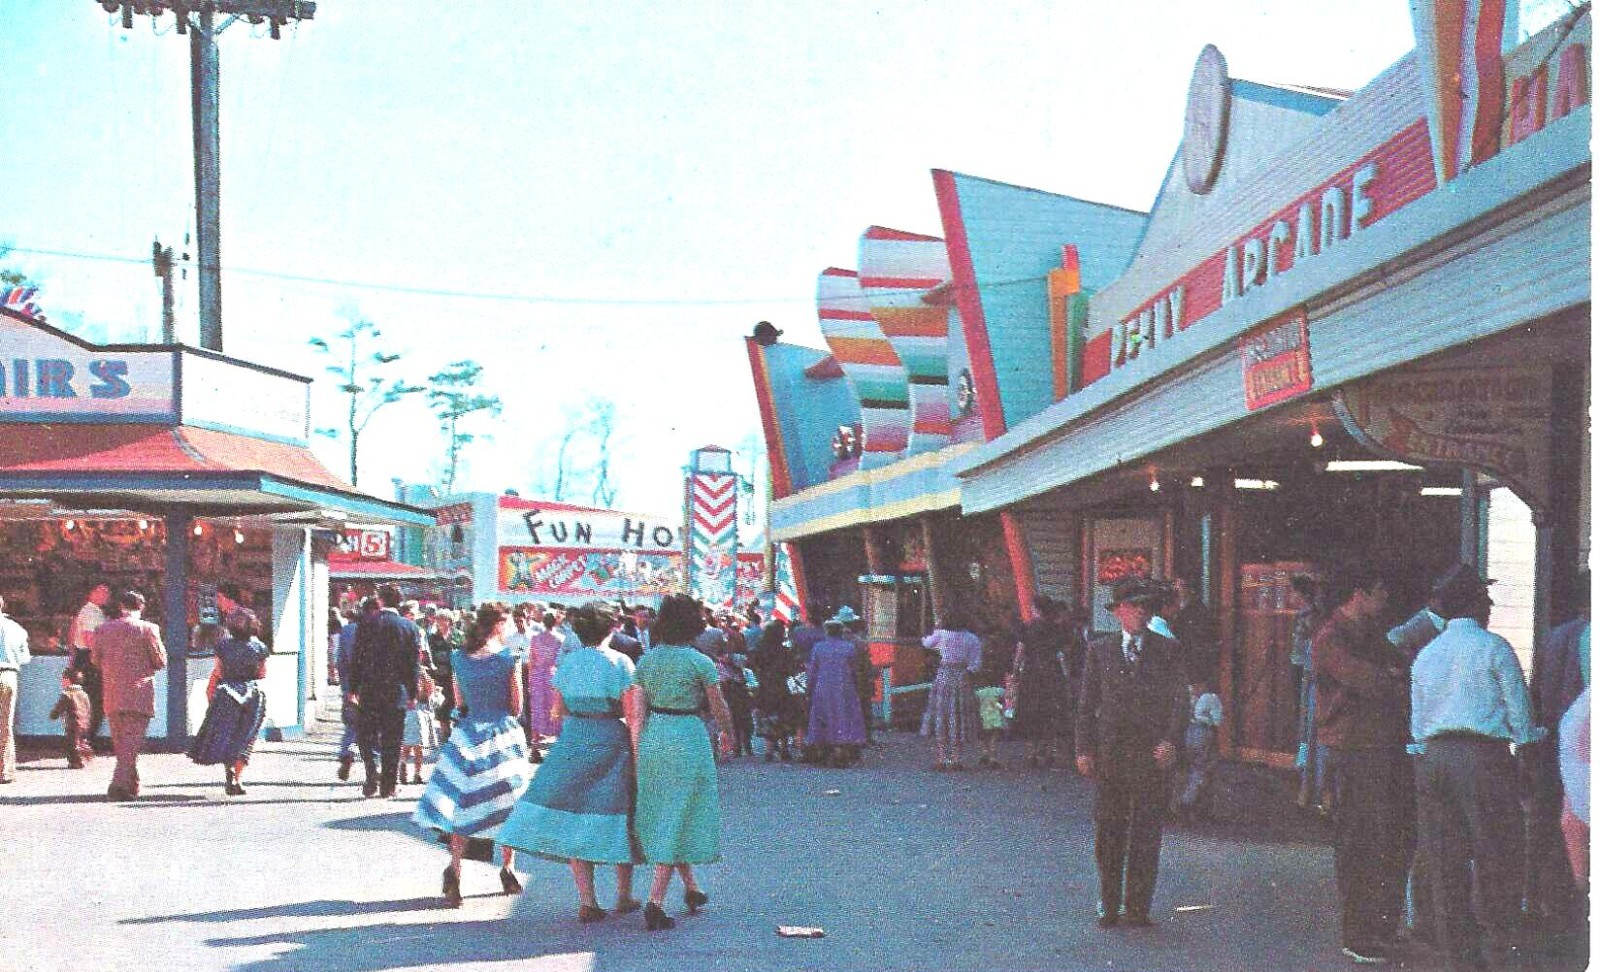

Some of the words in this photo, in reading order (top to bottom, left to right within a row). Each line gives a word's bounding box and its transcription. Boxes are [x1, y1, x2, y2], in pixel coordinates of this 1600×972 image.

[1222, 162, 1380, 305] ARCADE
[0, 359, 131, 399] IRS
[523, 509, 592, 545] FUN
[622, 517, 684, 548] HO
